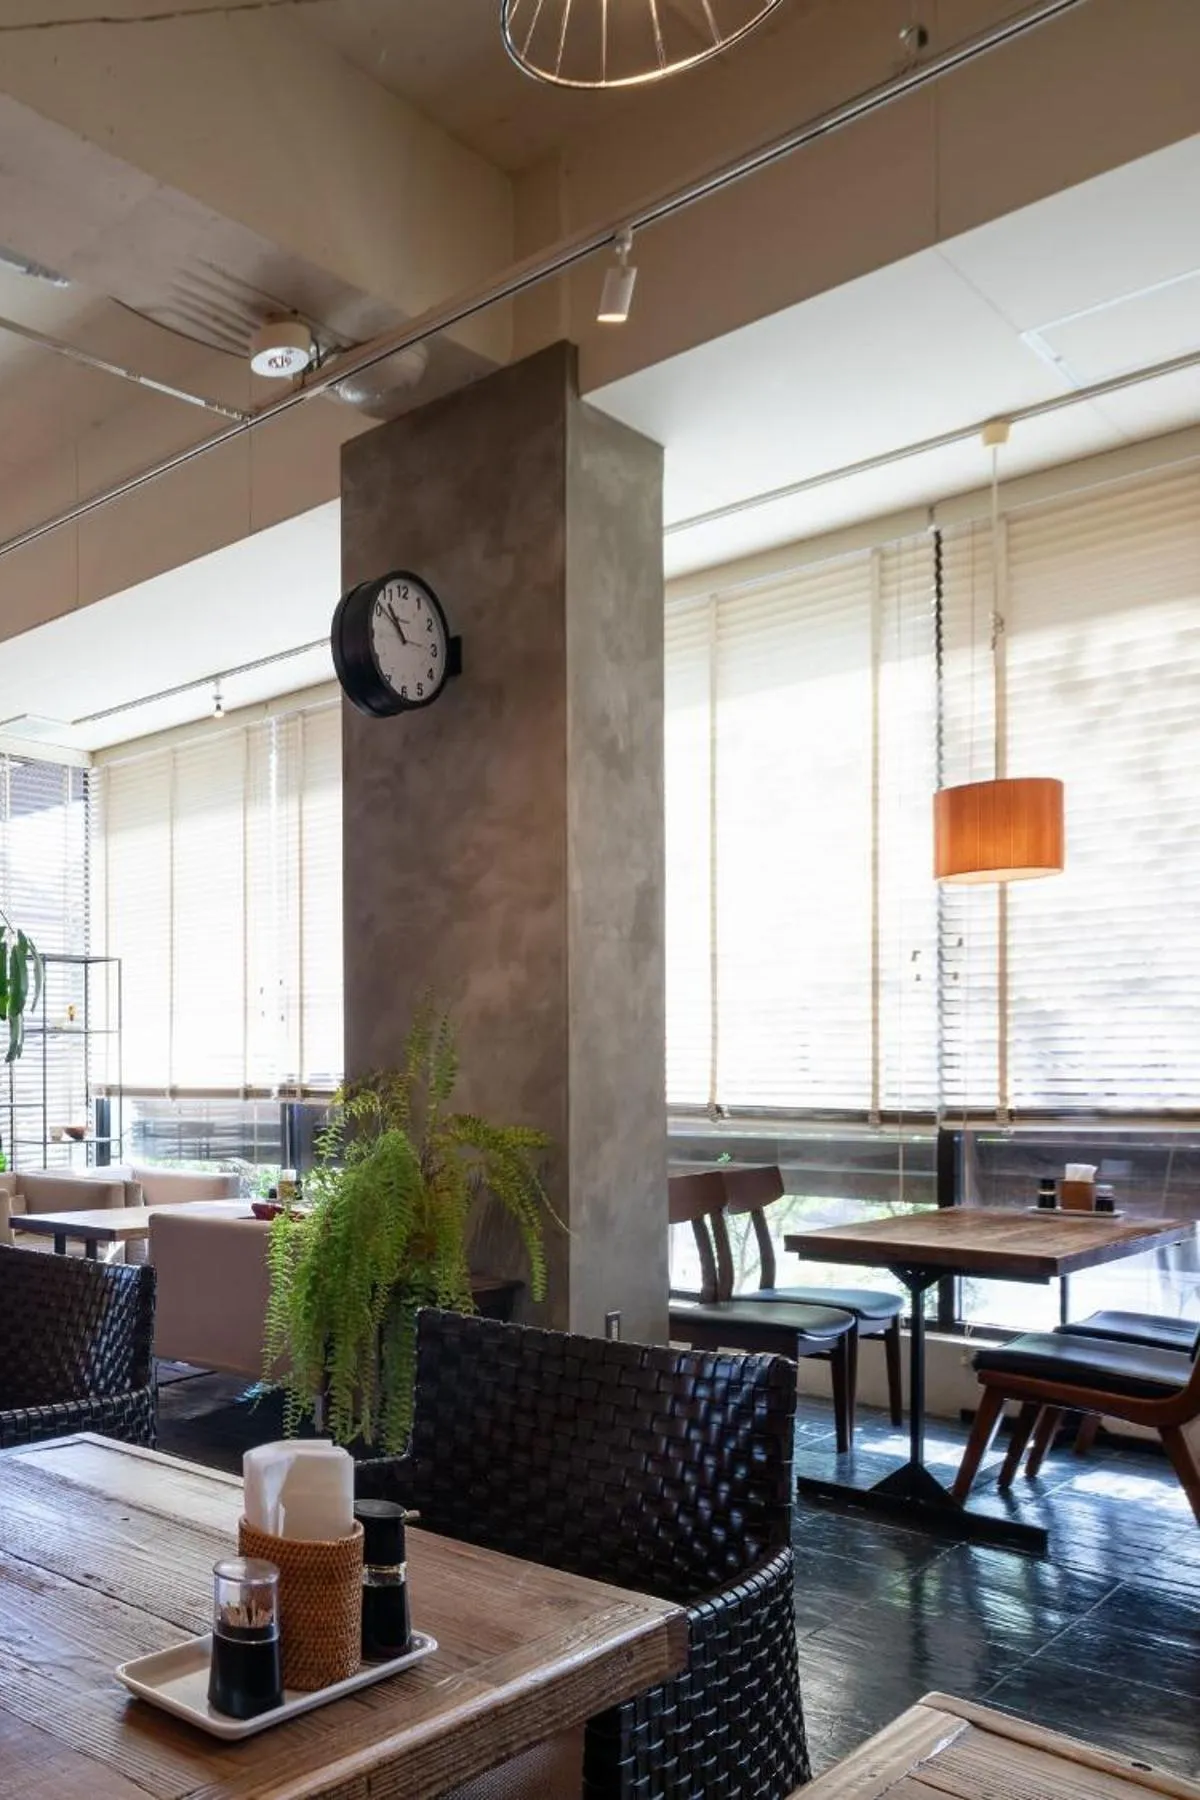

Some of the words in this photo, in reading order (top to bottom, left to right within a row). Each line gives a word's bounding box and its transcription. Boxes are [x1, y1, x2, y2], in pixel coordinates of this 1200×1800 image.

[397, 585, 409, 600] 12
[416, 597, 422, 611] 1
[427, 618, 434, 633] 2
[431, 643, 438, 658] 3
[427, 668, 435, 681] 4
[417, 682, 424, 697] 5
